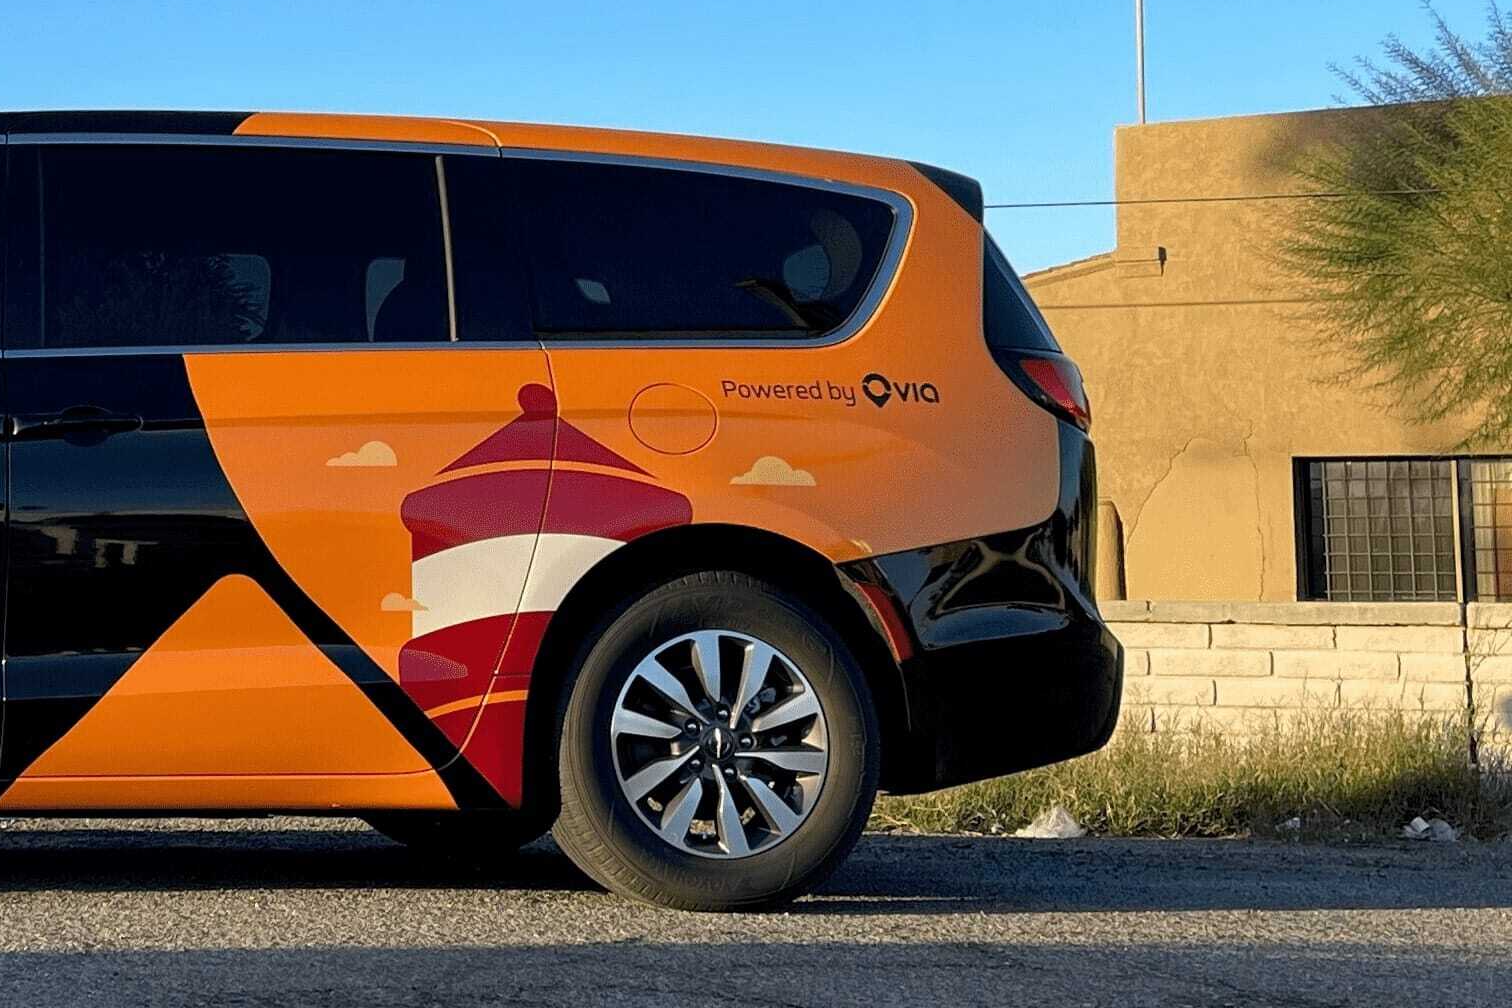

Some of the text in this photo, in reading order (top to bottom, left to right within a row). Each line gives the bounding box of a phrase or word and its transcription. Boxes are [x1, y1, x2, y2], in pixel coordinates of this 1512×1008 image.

[721, 380, 940, 407] Powered by via
